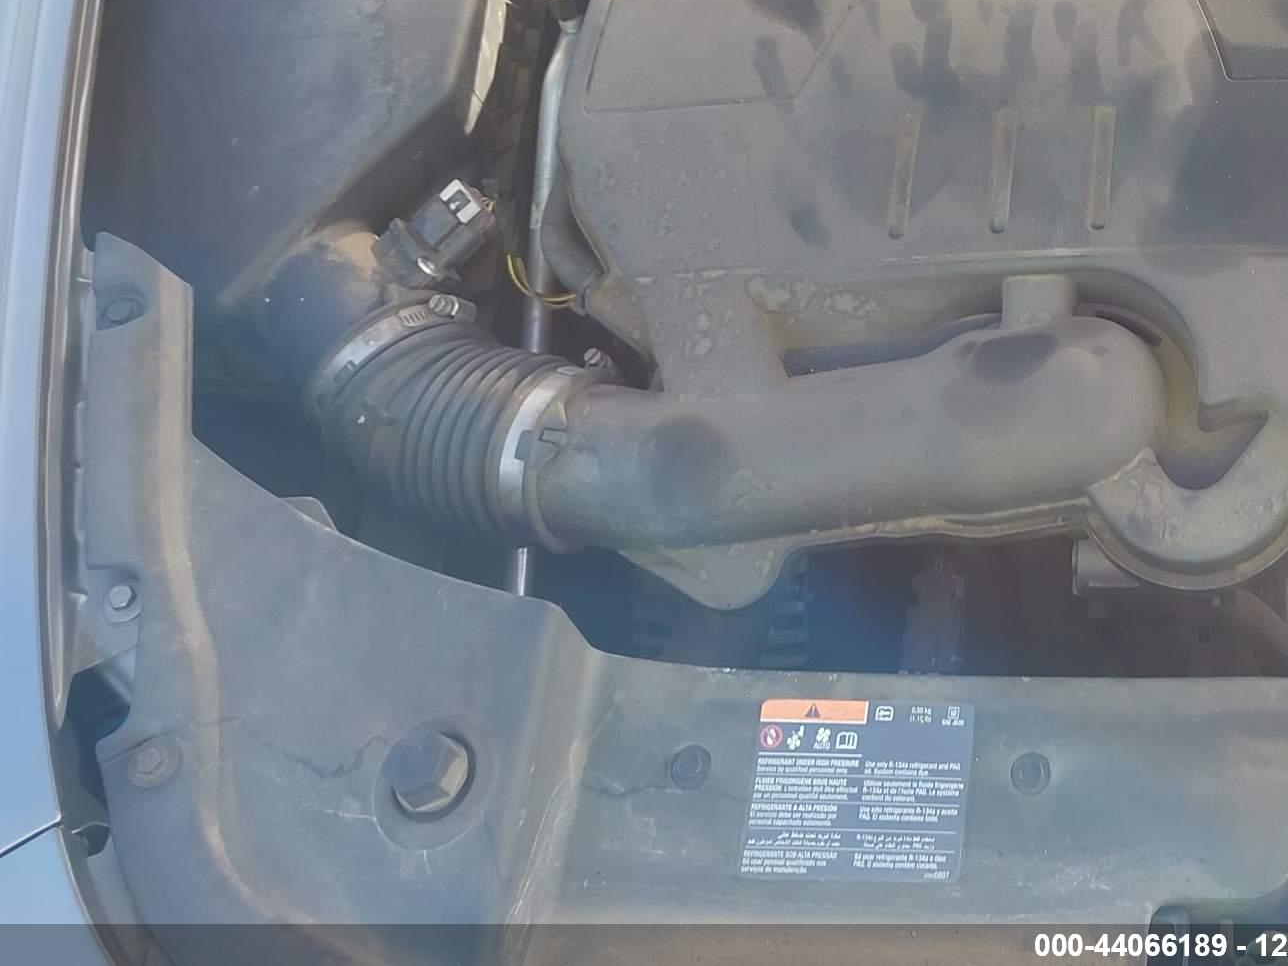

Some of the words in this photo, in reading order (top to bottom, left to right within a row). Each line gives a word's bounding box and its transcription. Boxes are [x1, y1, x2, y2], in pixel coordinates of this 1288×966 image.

[813, 741, 831, 750] AUTO
[757, 757, 796, 766] REFRIGERANT
[796, 758, 815, 766] UNDER
[816, 758, 830, 766] HIGH
[830, 758, 860, 767] PRESSURE
